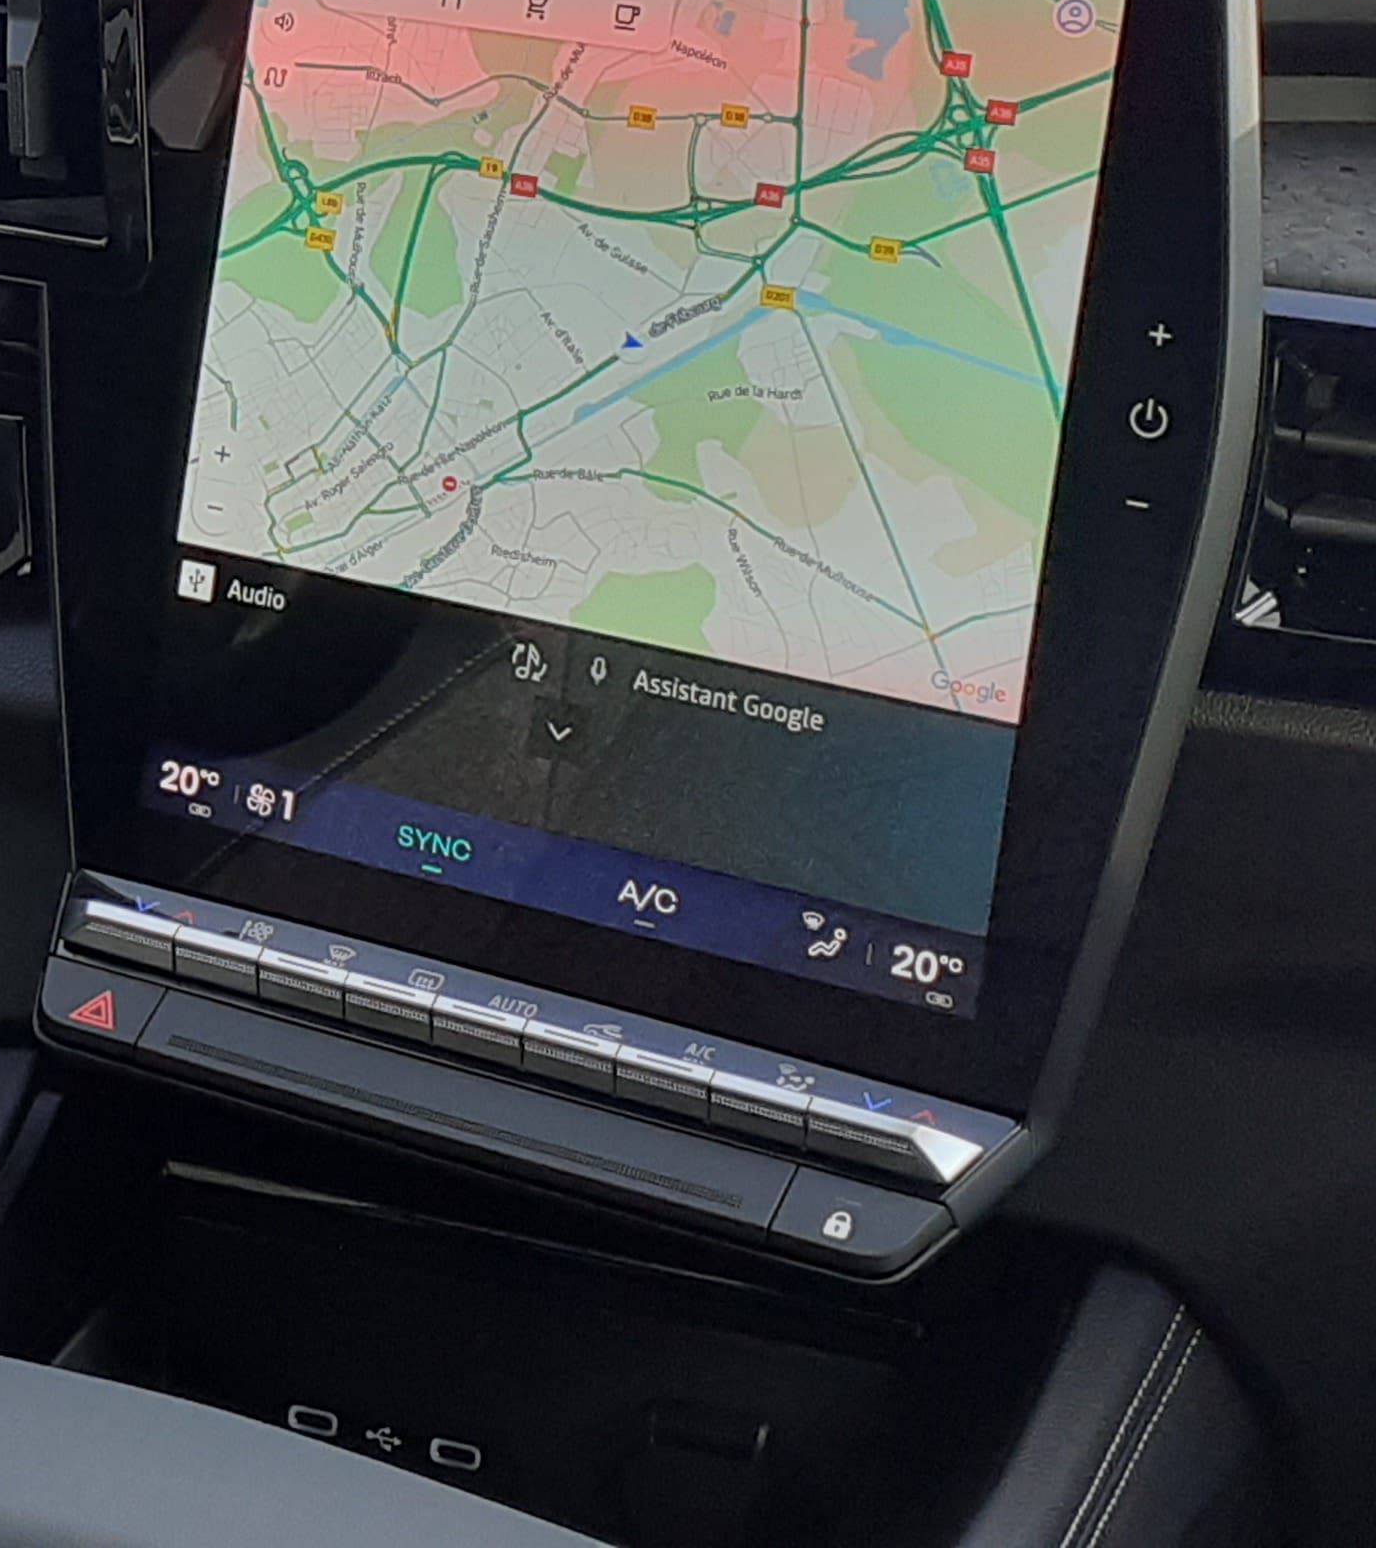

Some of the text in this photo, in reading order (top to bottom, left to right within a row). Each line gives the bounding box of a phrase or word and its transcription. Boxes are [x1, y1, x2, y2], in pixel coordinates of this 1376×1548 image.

[226, 578, 287, 611] Audio
[632, 669, 825, 733] Assistant Google
[930, 669, 1007, 704] Google
[280, 788, 296, 822] 1
[397, 824, 473, 862] SYNC
[617, 879, 679, 915] A/C
[487, 992, 539, 1020] AUTO
